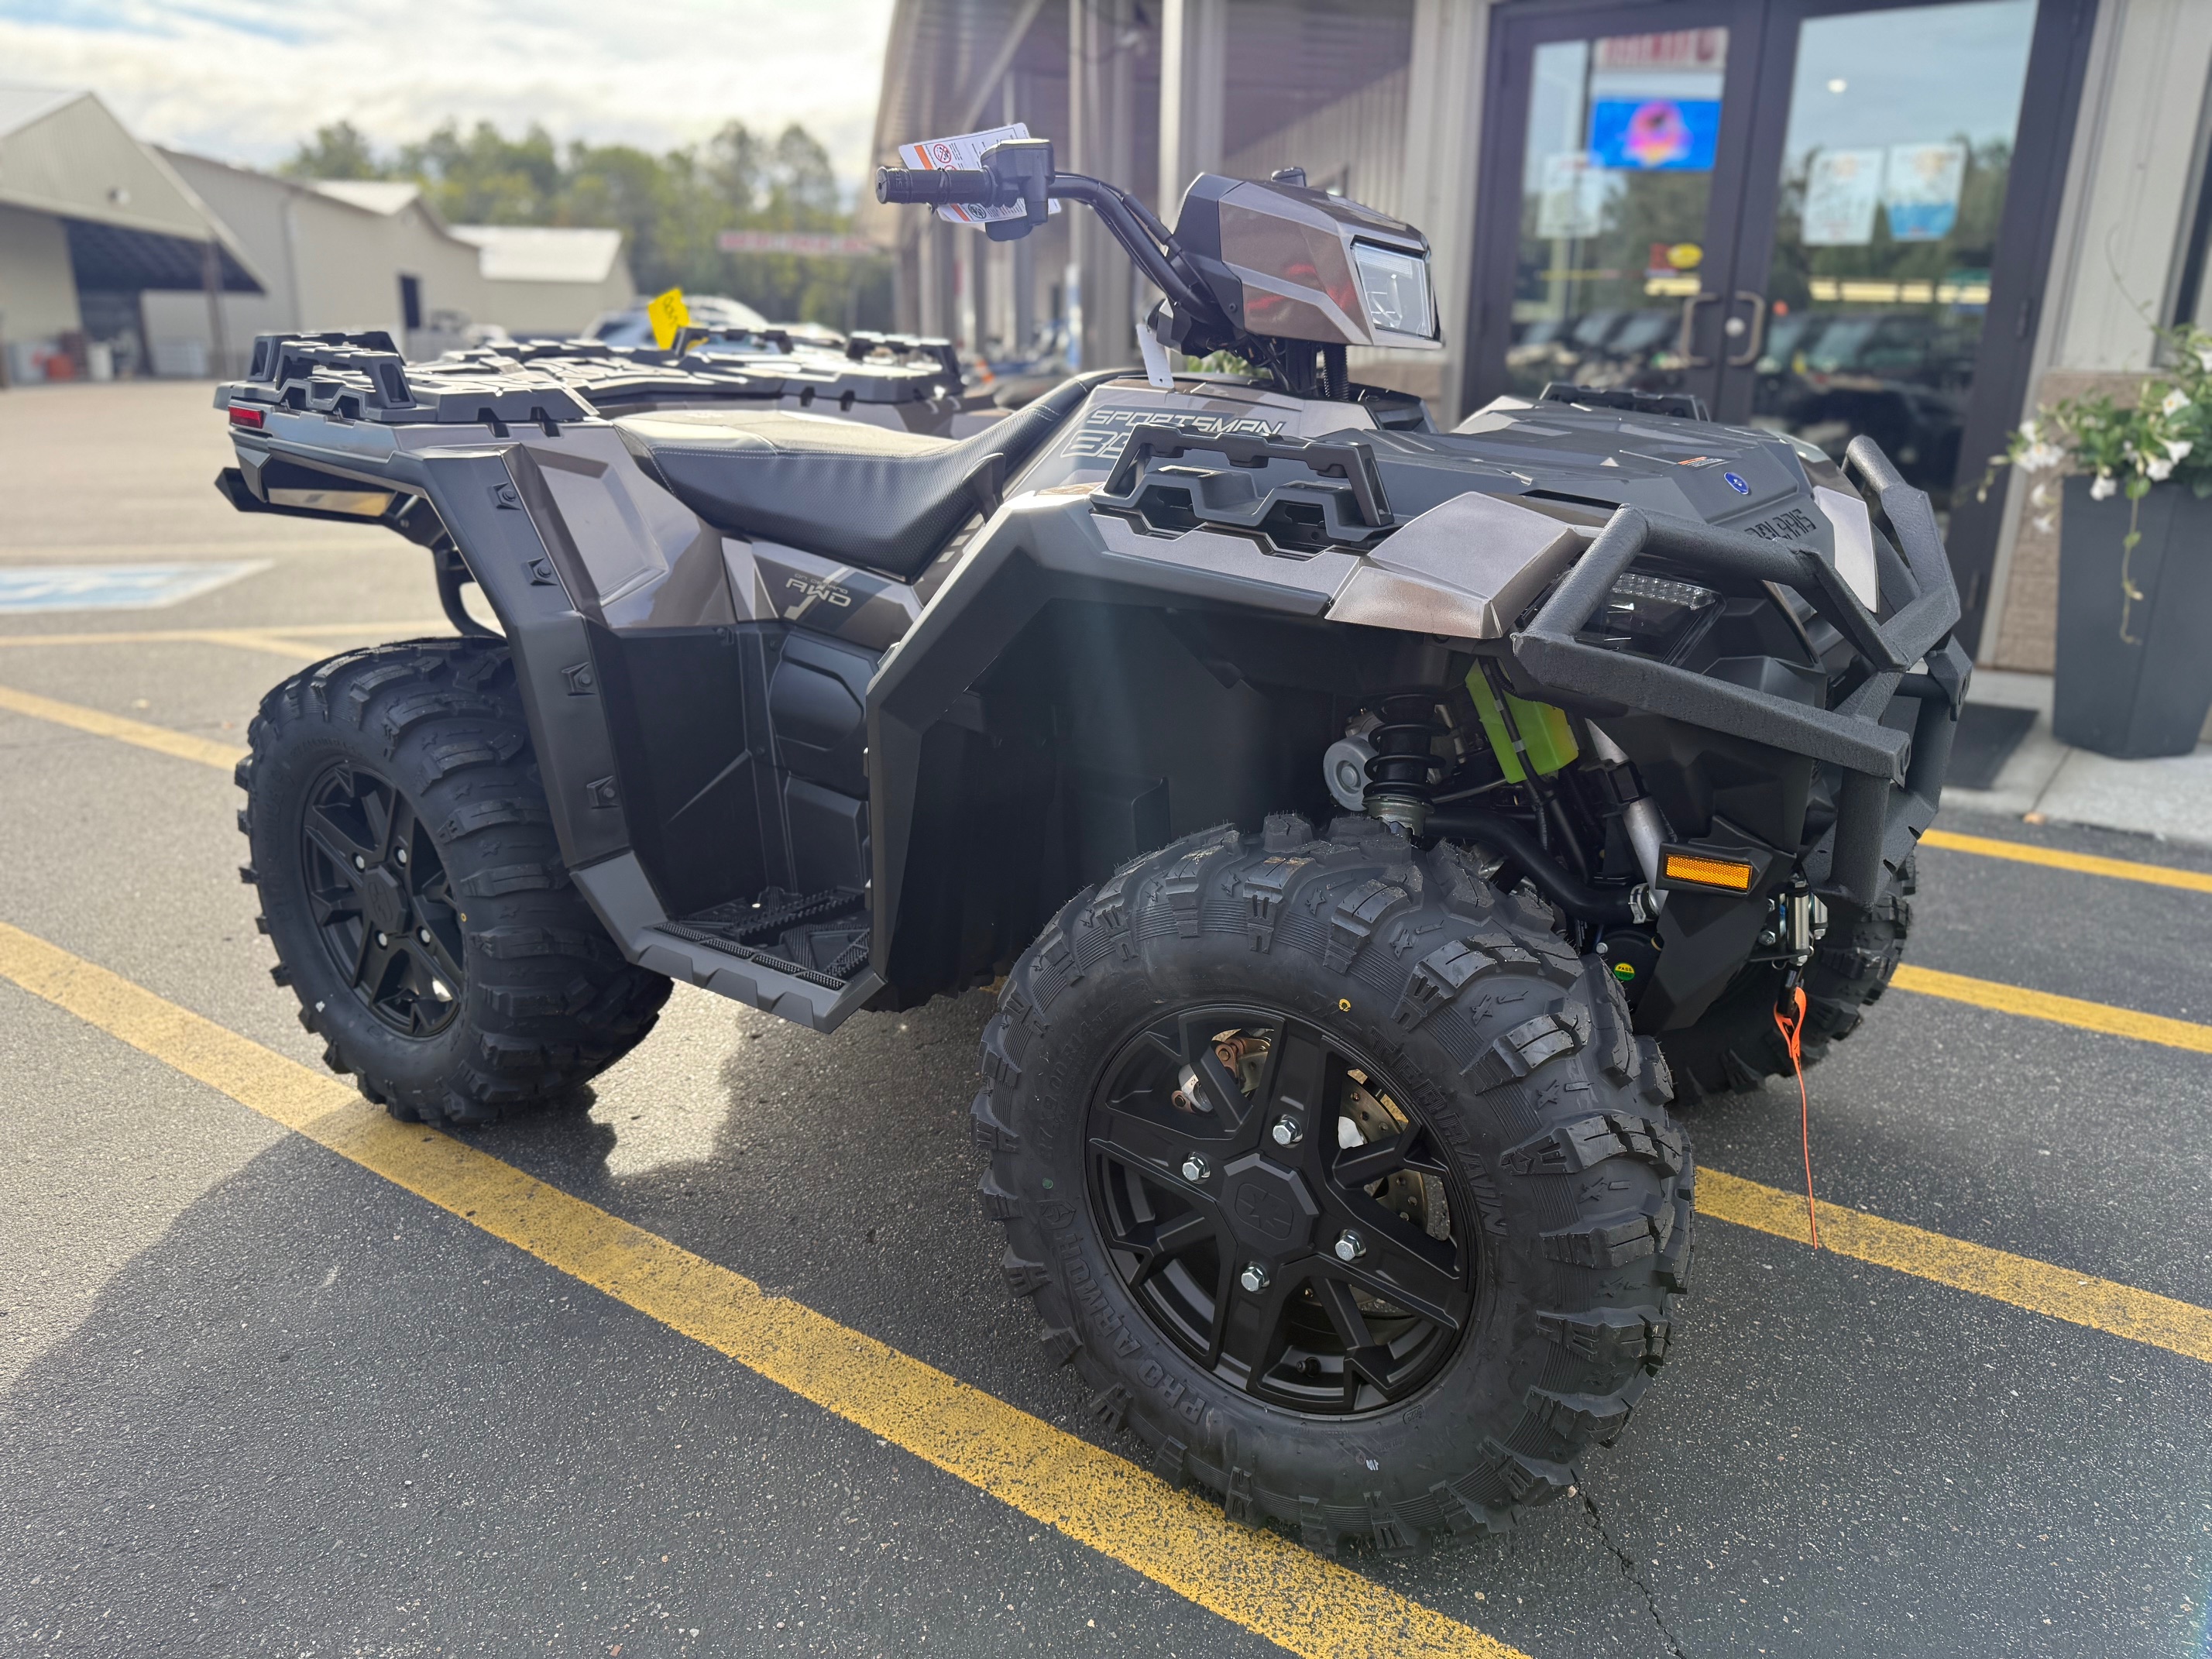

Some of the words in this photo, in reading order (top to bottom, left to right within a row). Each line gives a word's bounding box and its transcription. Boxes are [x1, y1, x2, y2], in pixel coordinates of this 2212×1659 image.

[1087, 410, 1286, 434] SPORTSMAN
[785, 578, 852, 607] AWD
[1058, 1232, 1142, 1358] ARMOR
[1137, 1357, 1207, 1425] PRO
